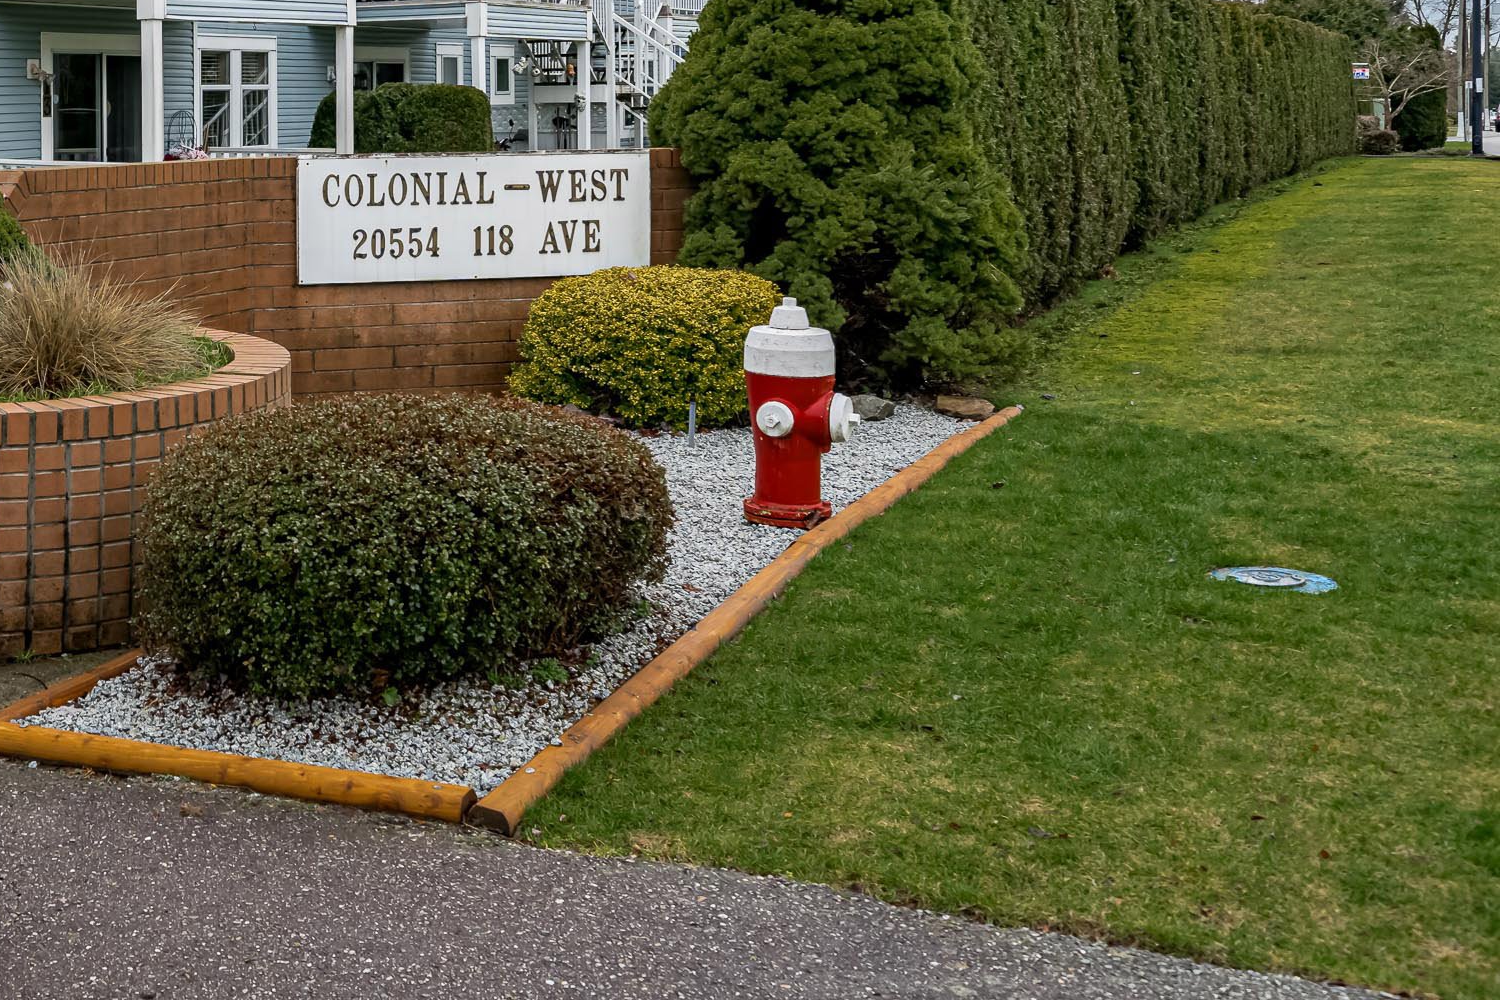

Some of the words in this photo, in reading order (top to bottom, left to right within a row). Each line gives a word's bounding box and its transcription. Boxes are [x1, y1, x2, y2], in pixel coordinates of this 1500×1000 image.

[322, 172, 495, 208] COLONIAL
[535, 168, 629, 203] WEST
[352, 226, 440, 261] 20554
[473, 224, 515, 257] 118
[538, 219, 601, 255] AVE
